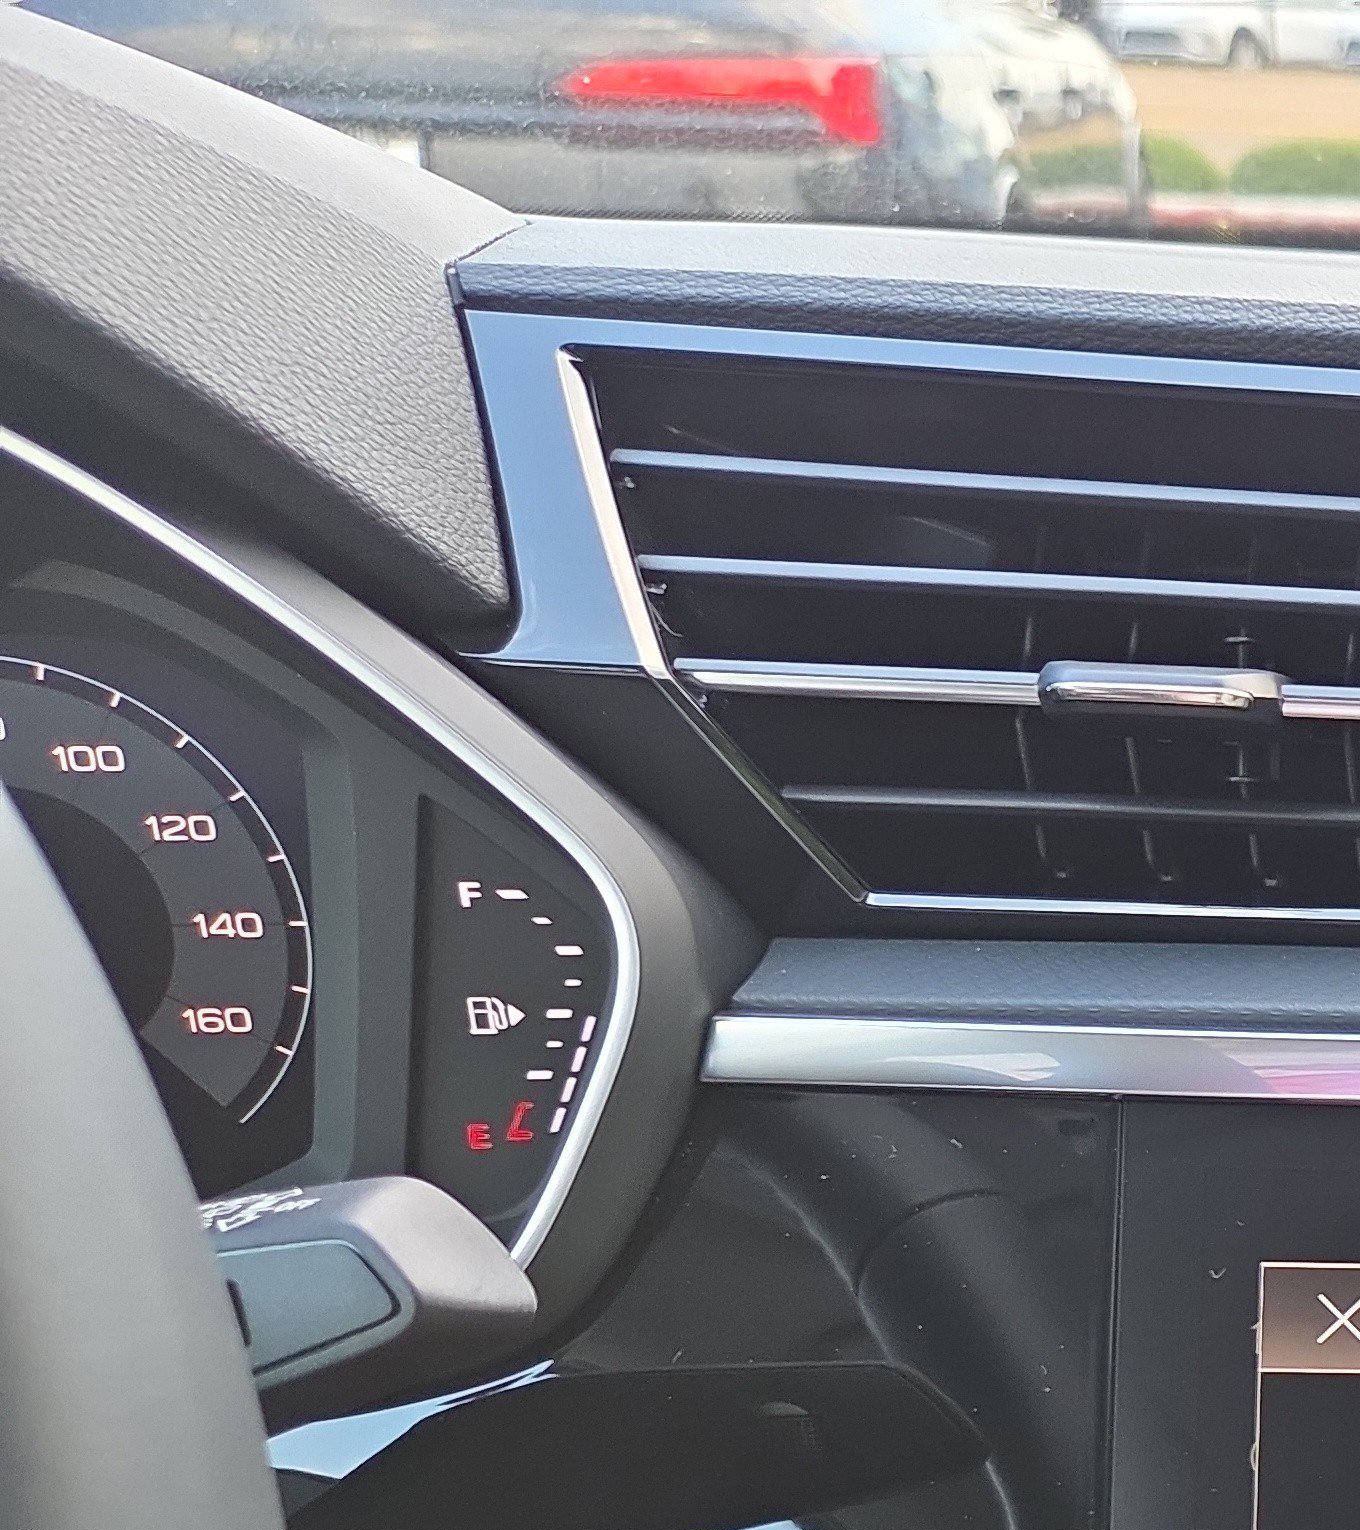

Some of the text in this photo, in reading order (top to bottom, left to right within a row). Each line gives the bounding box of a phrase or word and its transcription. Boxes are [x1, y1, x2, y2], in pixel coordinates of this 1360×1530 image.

[50, 744, 127, 773] 100
[143, 814, 217, 842] 120
[457, 881, 483, 908] F
[191, 911, 264, 939] 140
[181, 1007, 254, 1034] 160
[466, 1123, 494, 1151] E
